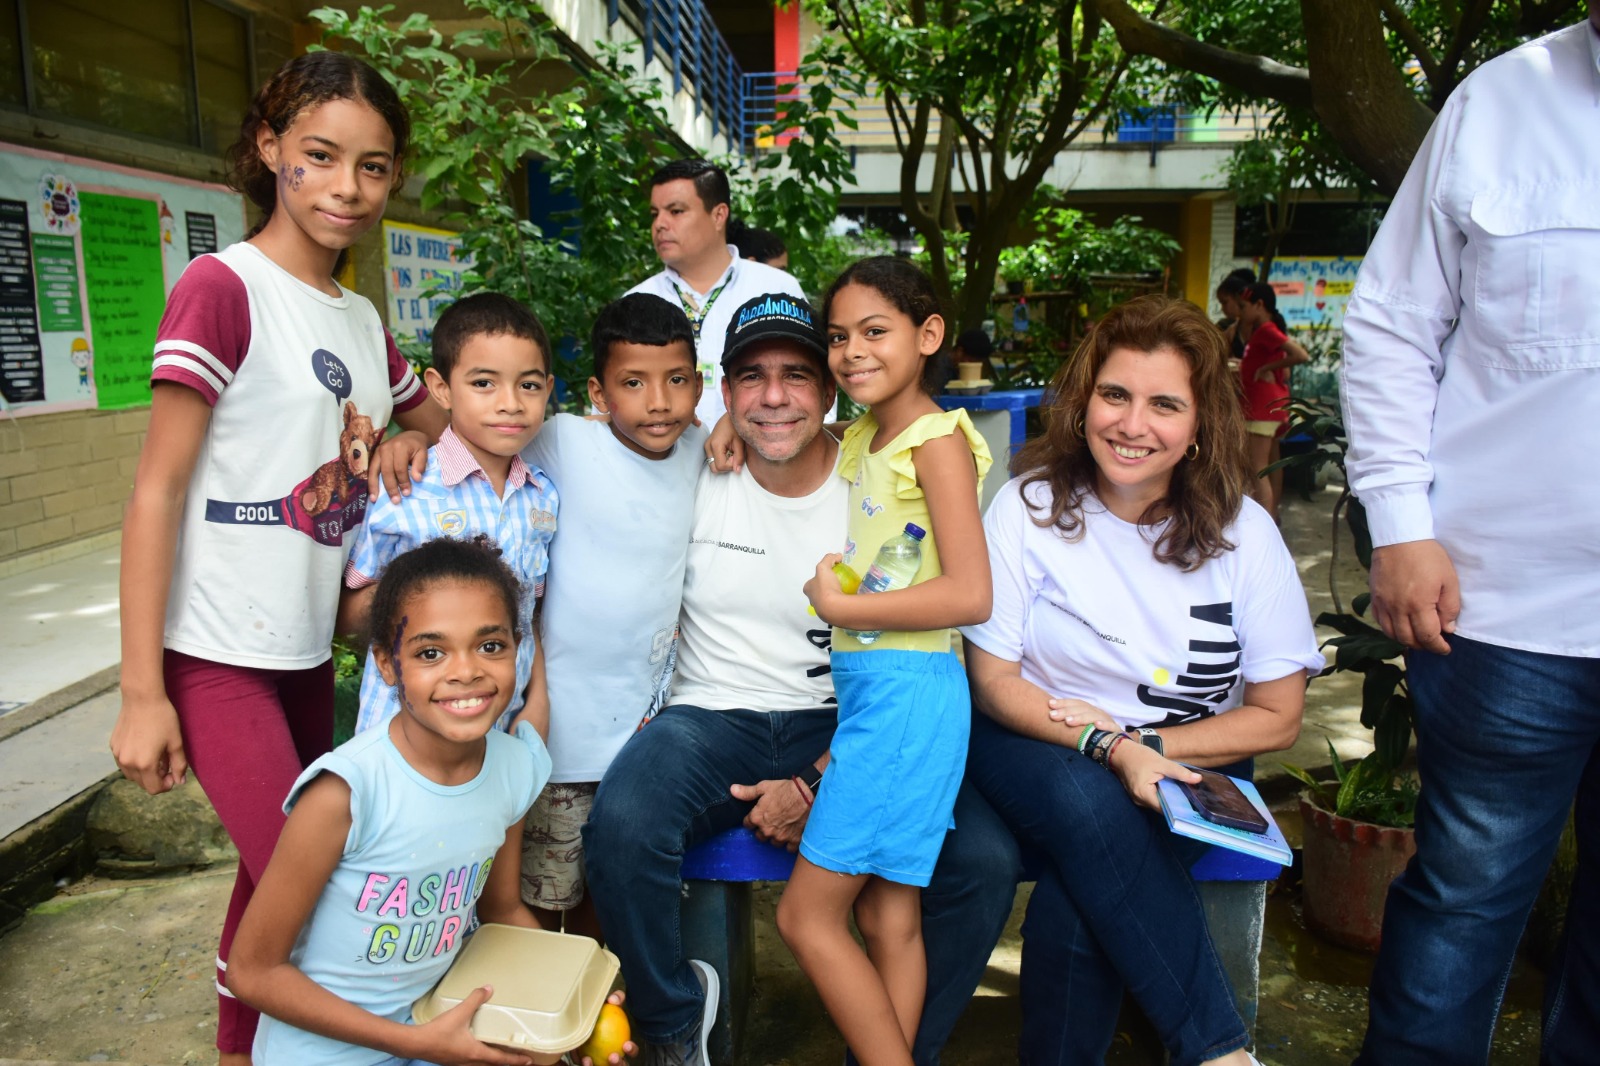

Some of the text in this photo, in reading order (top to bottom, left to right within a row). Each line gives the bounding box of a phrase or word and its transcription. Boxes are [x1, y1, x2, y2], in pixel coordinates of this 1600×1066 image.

[323, 355, 345, 377] Let's
[326, 370, 343, 388] Go
[235, 505, 280, 521] COOL
